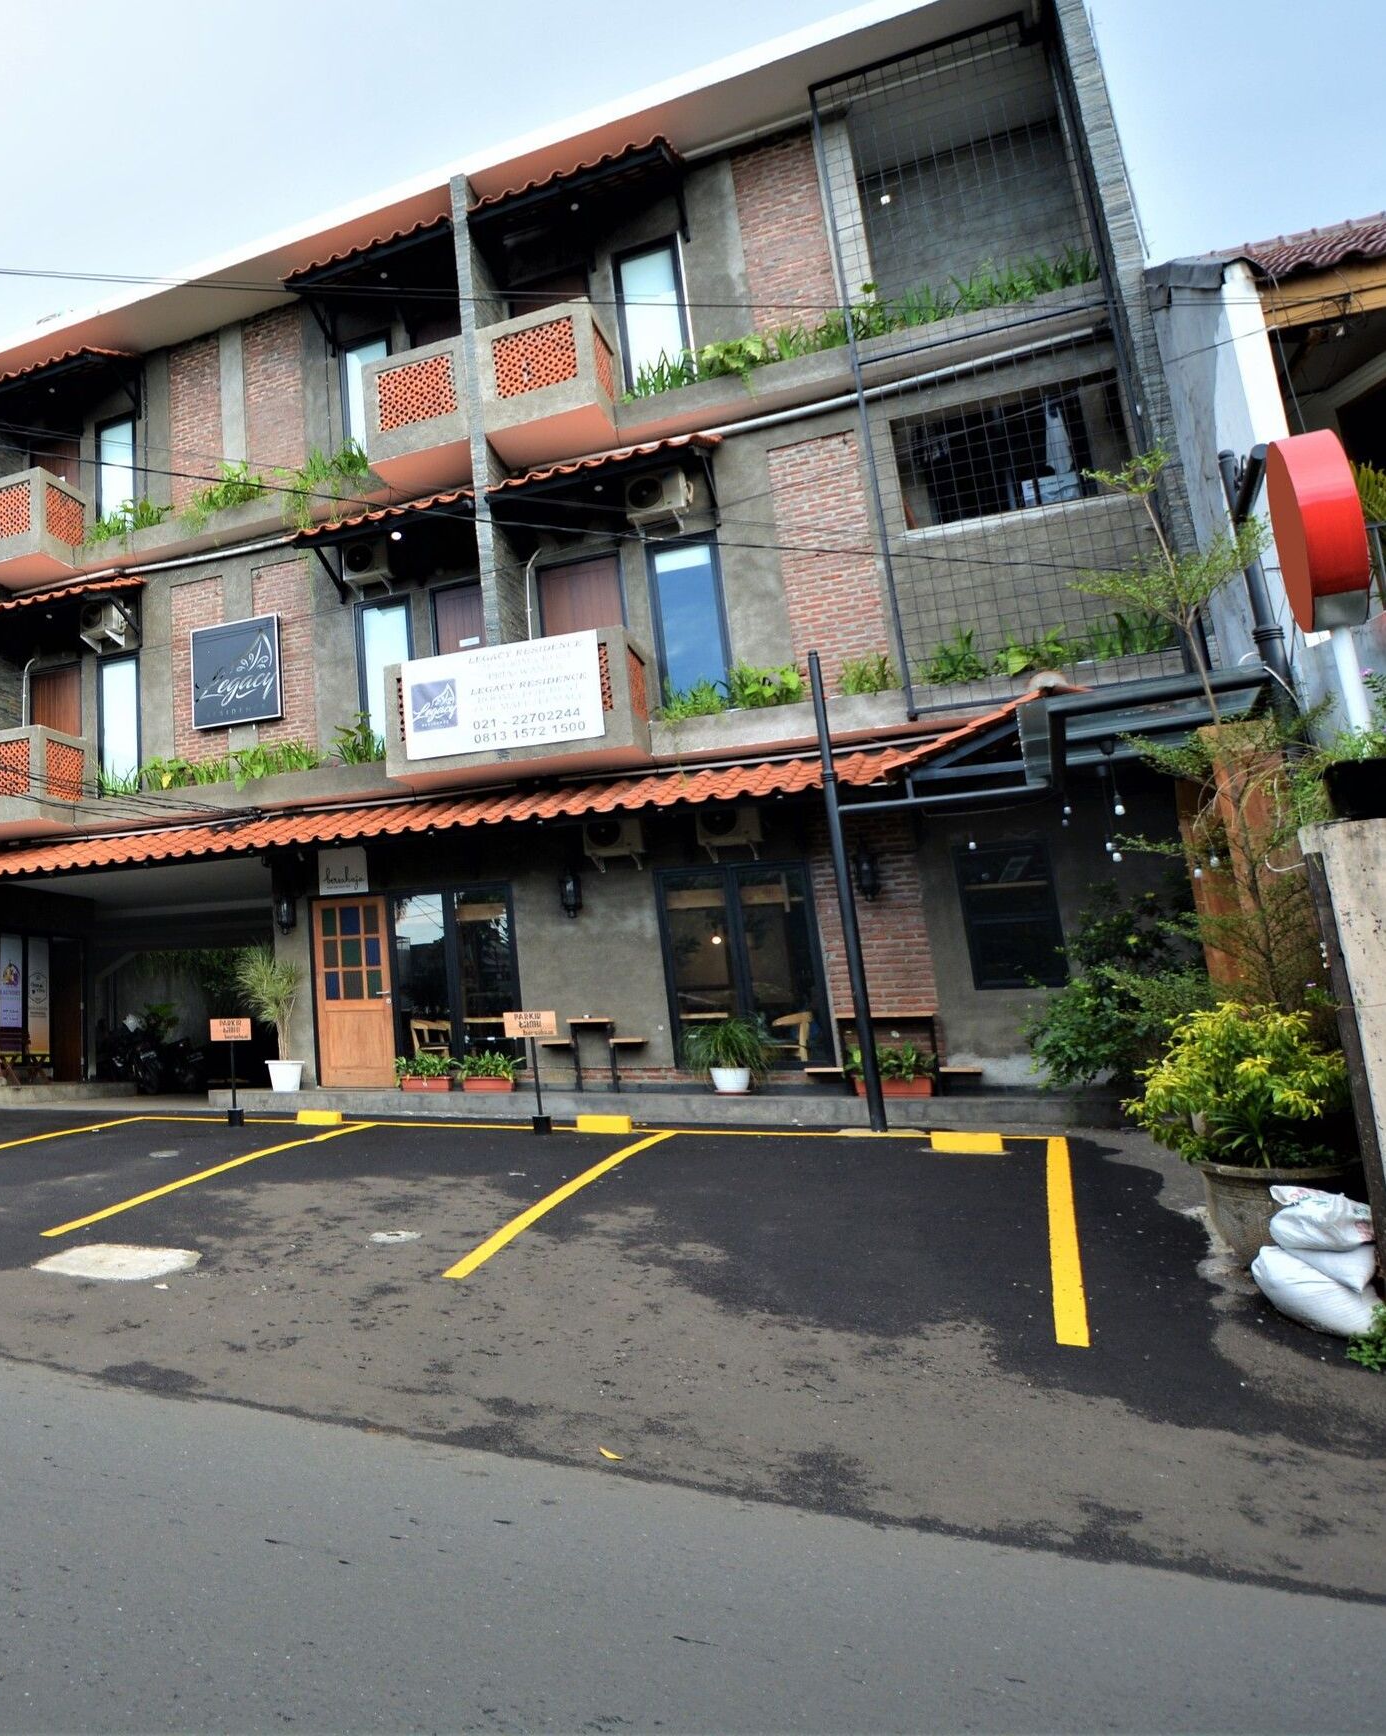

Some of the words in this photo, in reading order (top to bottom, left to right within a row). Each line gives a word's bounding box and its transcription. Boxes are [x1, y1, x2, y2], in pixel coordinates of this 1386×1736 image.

[468, 650, 511, 665] LEGACY
[514, 640, 583, 657] RESIDENCE
[199, 672, 276, 706] Legacy
[470, 681, 515, 696] LEGACY
[519, 672, 588, 690] RESIDENCE
[413, 702, 457, 722] Legacy
[473, 717, 497, 730] 021
[512, 706, 581, 726] 22702244
[474, 730, 507, 744] 0813
[514, 724, 546, 740] 1572
[553, 720, 586, 735] 1500
